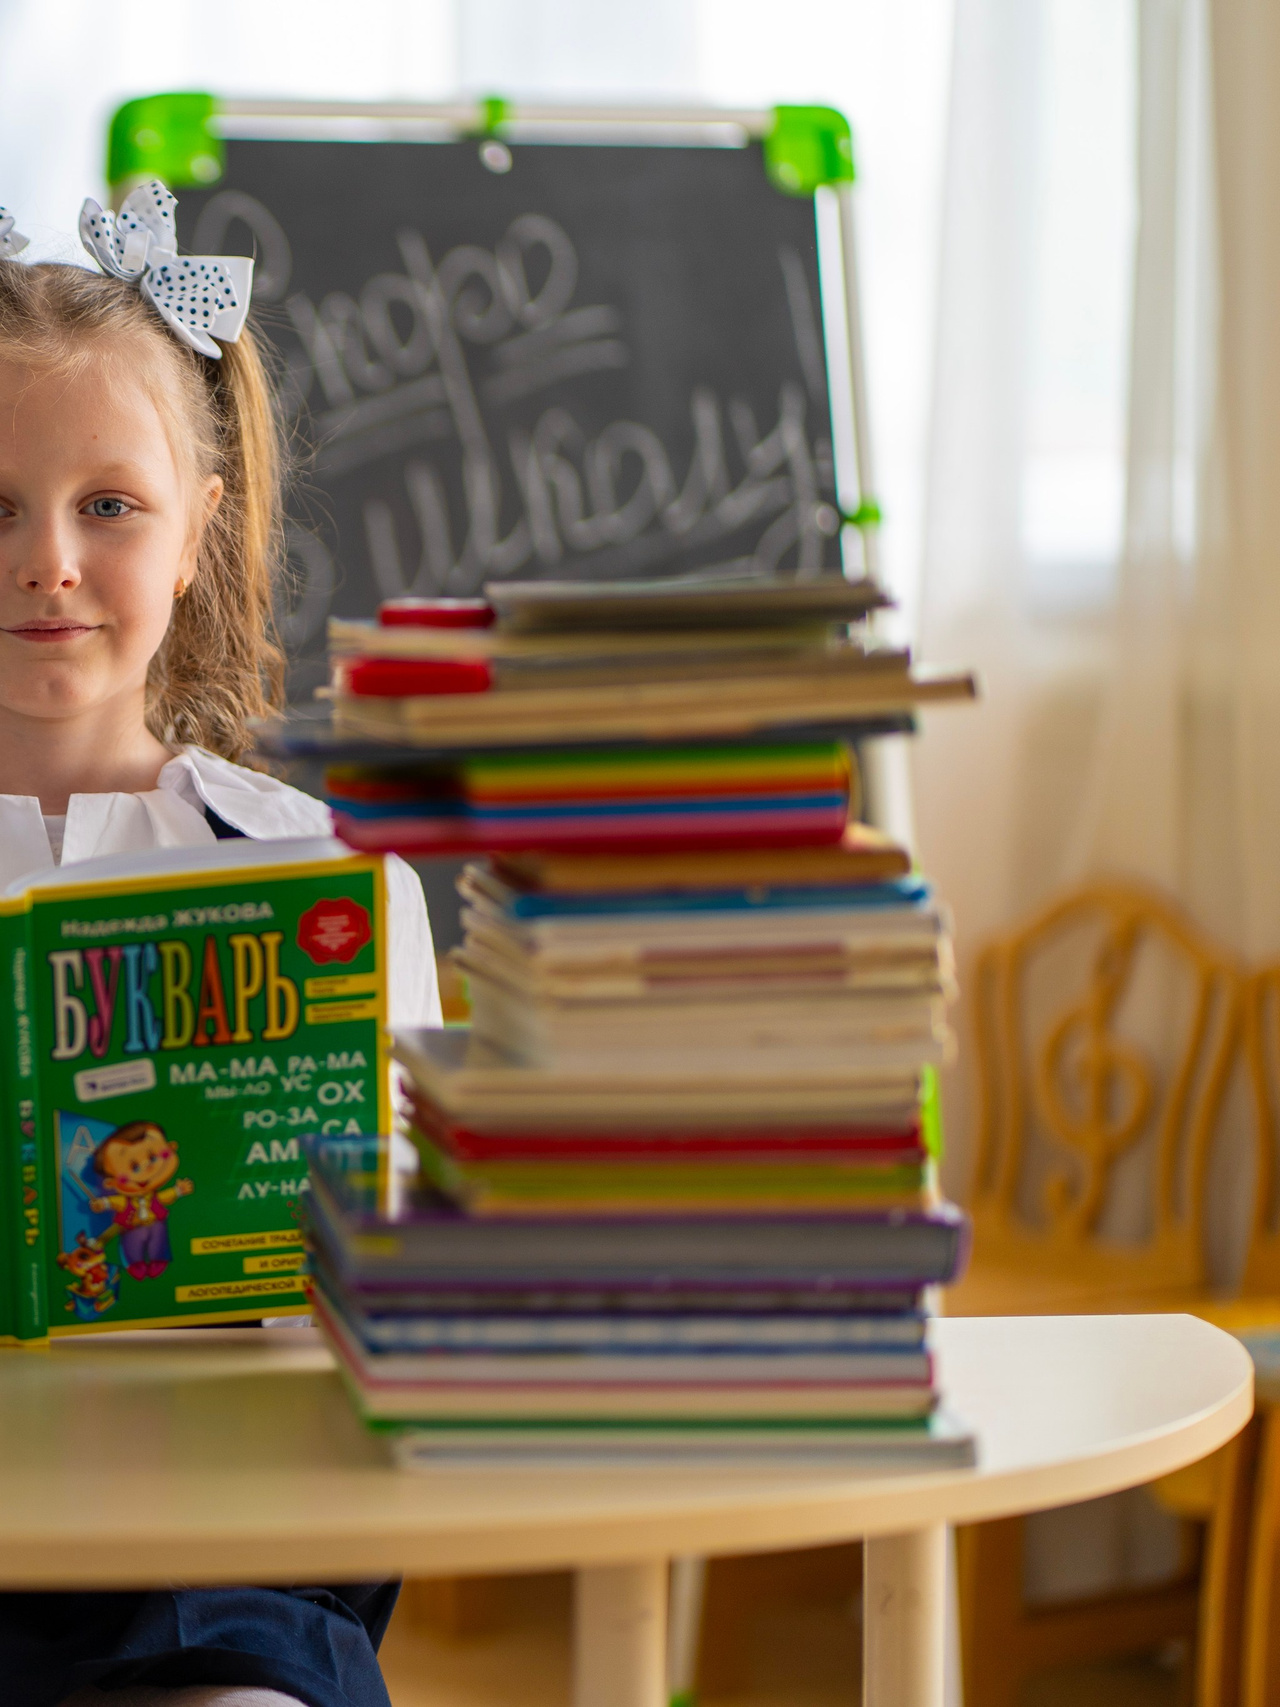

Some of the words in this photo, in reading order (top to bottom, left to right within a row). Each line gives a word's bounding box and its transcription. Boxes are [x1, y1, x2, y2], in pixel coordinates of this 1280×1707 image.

[61, 914, 168, 938] Надежда
[172, 902, 274, 928] ЖУКОВА
[47, 930, 300, 1060] БУКВАРЬ
[169, 1056, 279, 1085] МА-МА
[287, 1050, 368, 1073] РА-МА
[204, 1080, 271, 1099] МЫ-ЛО
[280, 1073, 313, 1093] УС
[317, 1078, 366, 1106] ОХ
[243, 1106, 319, 1129] РО-ЗА
[245, 1138, 300, 1165] АМ
[19, 1099, 40, 1247] БУКВАРЬ
[201, 1236, 266, 1249] СОЧЕТАНИЕ
[187, 1278, 296, 1298] ЛОГОПЕДИЧЕСКОЙ
